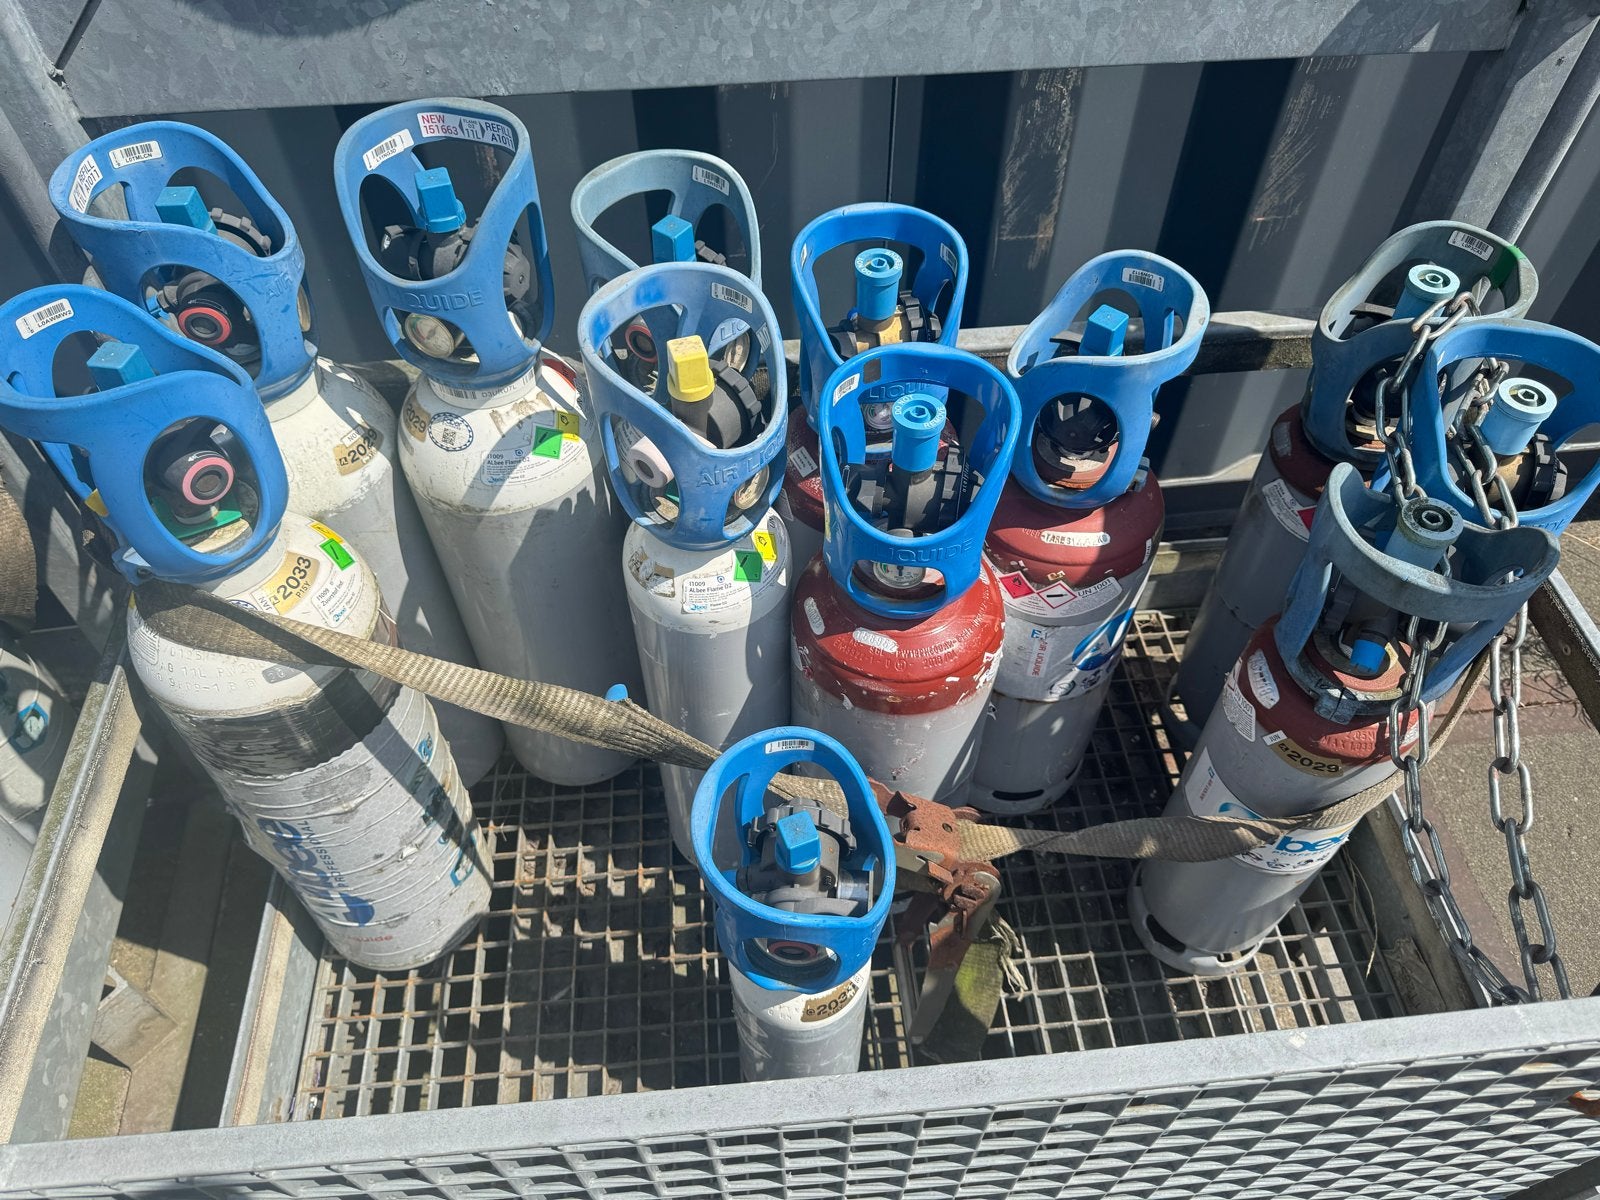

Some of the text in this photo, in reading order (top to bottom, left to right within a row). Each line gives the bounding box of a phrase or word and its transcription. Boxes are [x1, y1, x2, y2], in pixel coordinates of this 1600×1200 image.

[421, 115, 445, 124] NEW
[423, 125, 459, 136] 151663
[485, 122, 512, 138] REFILL
[465, 129, 481, 140] 11L
[78, 160, 95, 182] REFILL
[85, 170, 101, 192] A1011
[404, 401, 427, 434] 2029
[923, 404, 946, 429] REMOVE
[348, 428, 379, 465] 2029
[276, 556, 312, 601] 2033
[295, 580, 312, 599] P15Y
[1078, 578, 1113, 598] UN 1001
[258, 595, 274, 612] JAN
[1032, 651, 1045, 677] LIQUIDE
[1269, 733, 1281, 742] JUN
[1287, 752, 1341, 775] 2029
[297, 819, 350, 890] PROFESSIONAL
